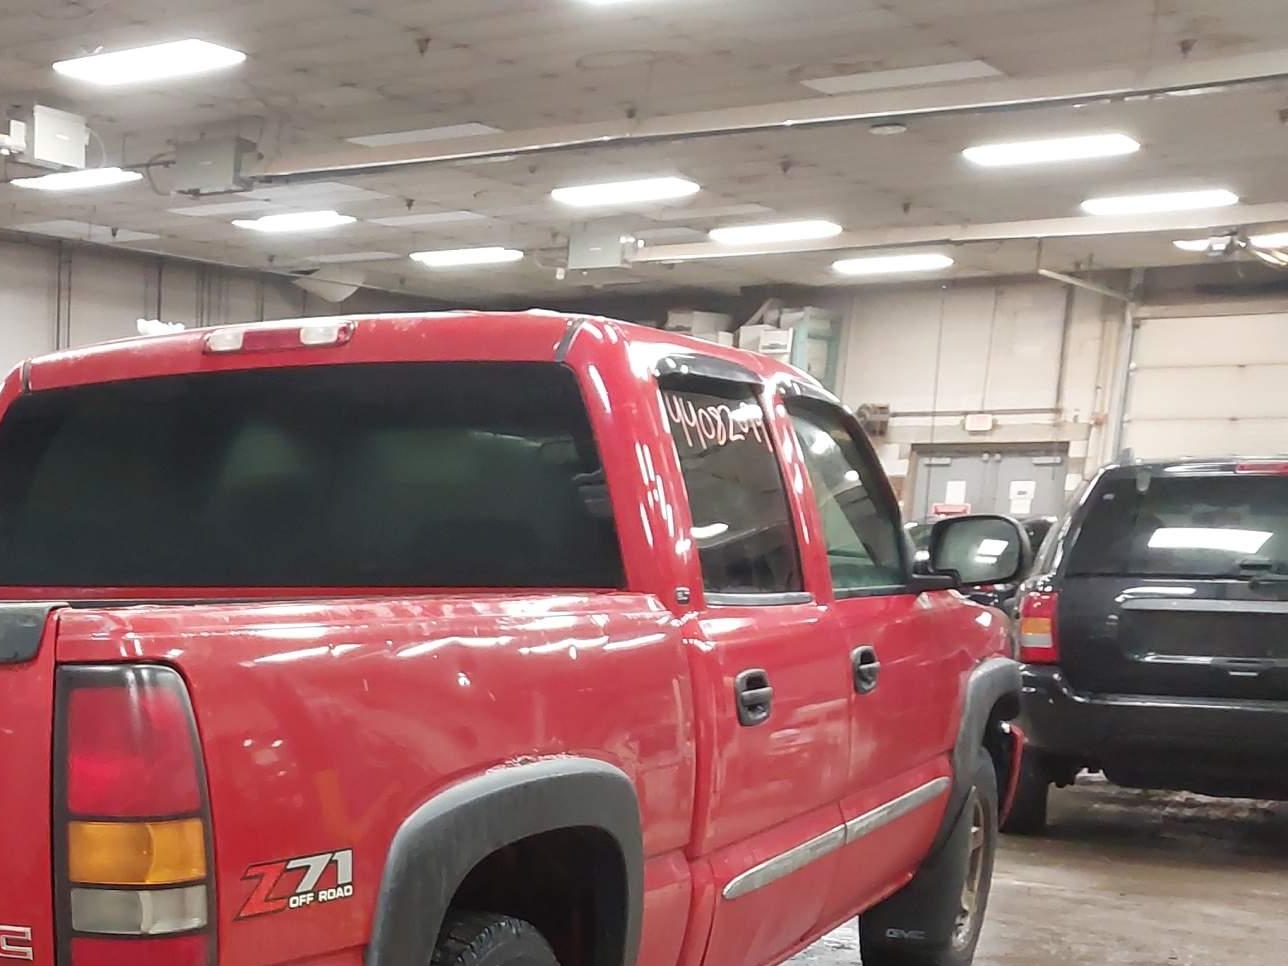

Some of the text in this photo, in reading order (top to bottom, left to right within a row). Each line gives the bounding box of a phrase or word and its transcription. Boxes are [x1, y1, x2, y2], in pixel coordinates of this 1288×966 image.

[234, 849, 353, 921] Z71
[289, 884, 353, 908] OFF ROAD
